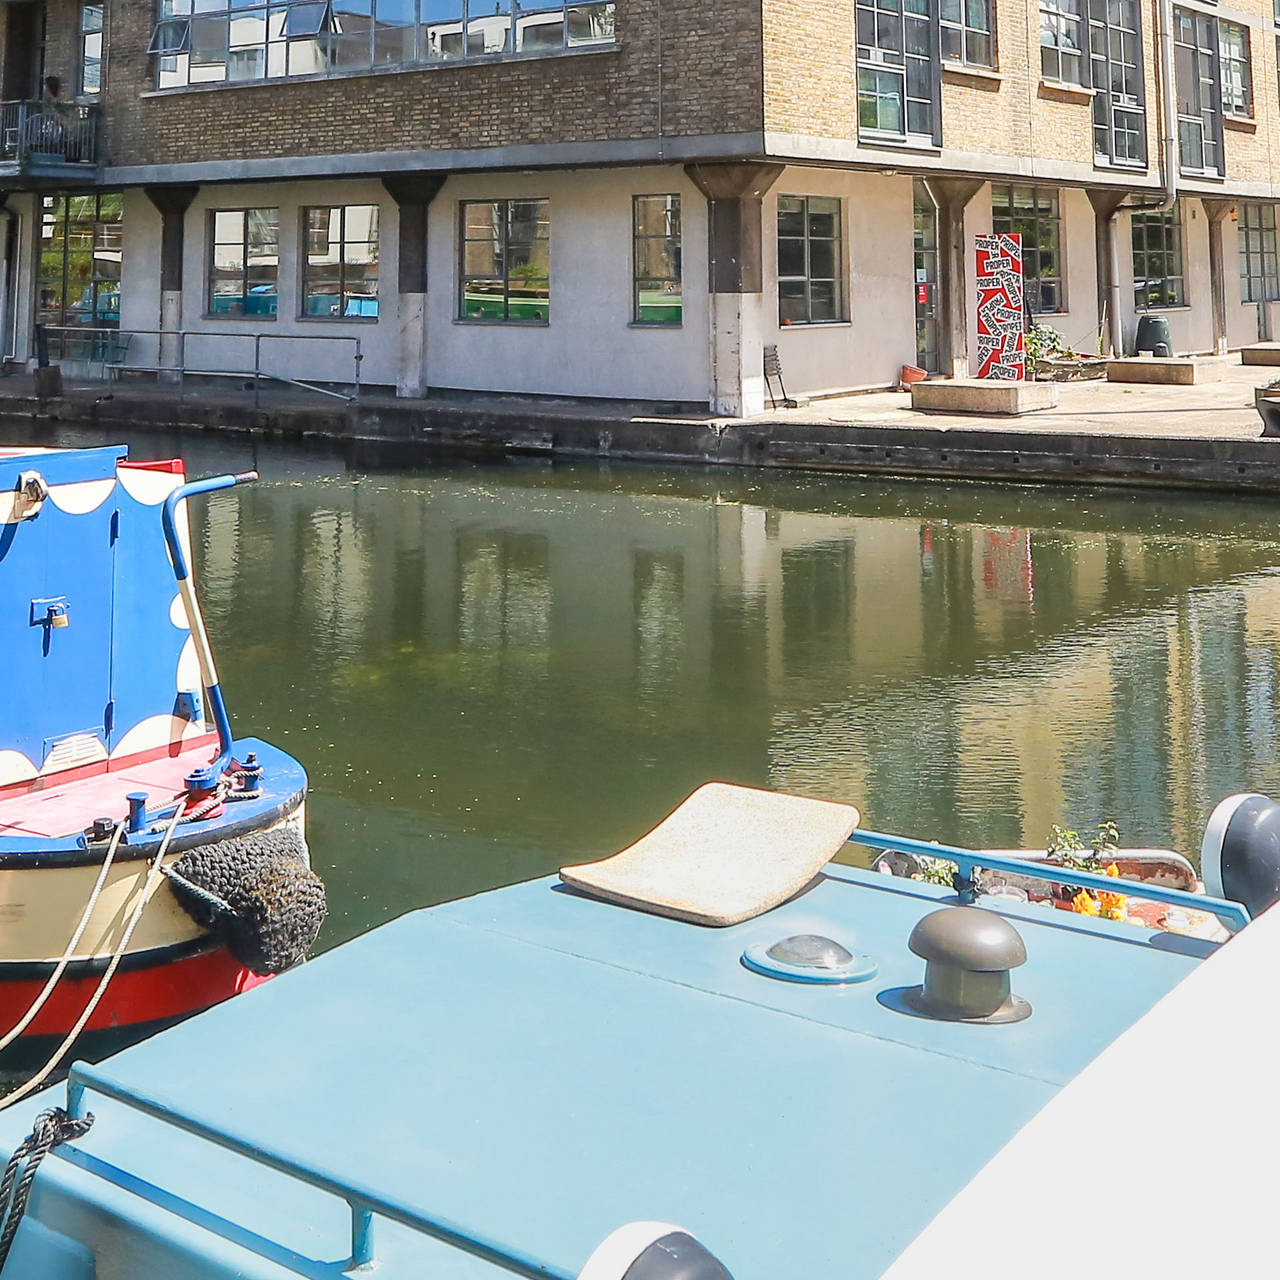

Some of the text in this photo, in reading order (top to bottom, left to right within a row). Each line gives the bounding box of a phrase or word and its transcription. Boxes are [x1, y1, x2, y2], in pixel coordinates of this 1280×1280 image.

[976, 239, 999, 250] PROPER
[986, 259, 1010, 271] PROPER
[977, 278, 1000, 287] PROPER
[1004, 278, 1020, 306] PROPER
[996, 308, 1021, 320] PROPER
